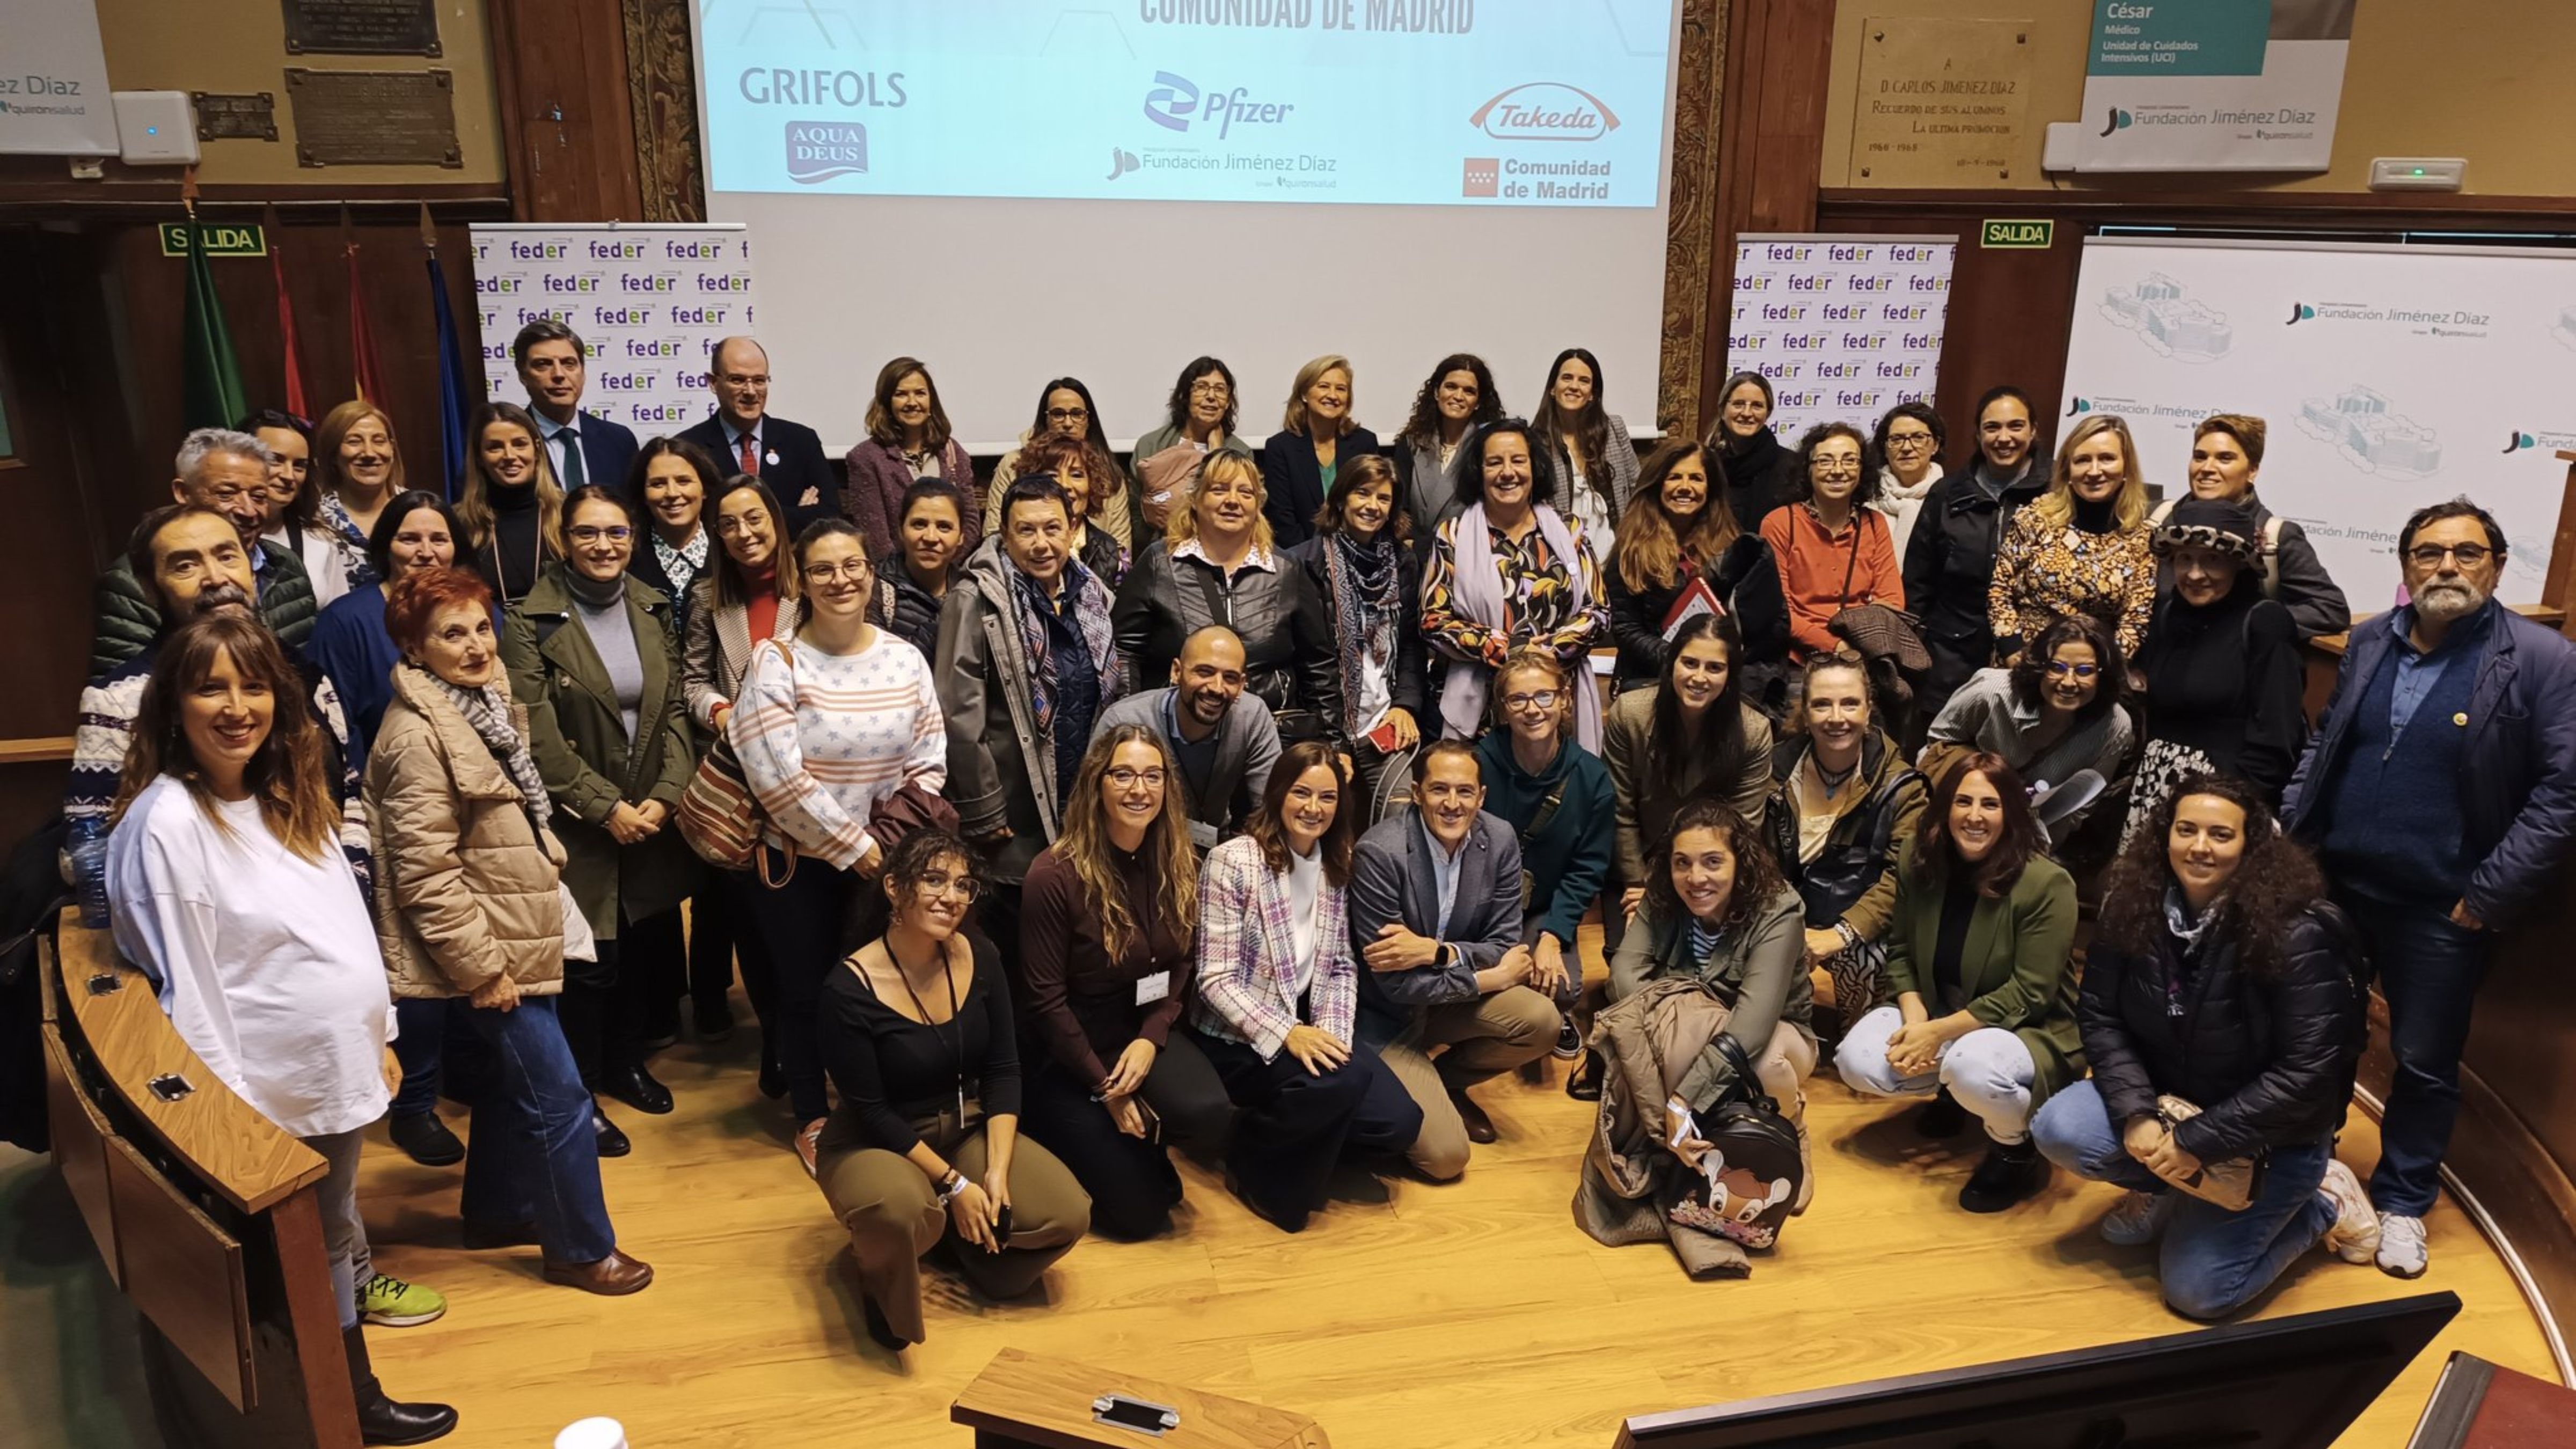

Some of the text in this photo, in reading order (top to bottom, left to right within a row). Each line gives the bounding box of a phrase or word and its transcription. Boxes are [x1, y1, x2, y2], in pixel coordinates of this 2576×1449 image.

[1140, 0, 1474, 34] COMUNIDAD DE MADRID
[2107, 2, 2154, 19] César
[2104, 25, 2141, 34] Médico
[2103, 40, 2199, 50] Unidad de Cuidados
[2101, 53, 2176, 64] Intensivos (UCI)
[740, 67, 907, 107] GRIFOLS
[1893, 80, 1935, 93] CARLOS
[1940, 80, 1988, 94] JIMENEZ
[1990, 81, 2016, 94] DIAZ
[1203, 87, 1294, 140] Pfizer
[1499, 105, 1597, 129] Takeda
[2134, 112, 2207, 125] Fundación
[2211, 109, 2275, 125] Jiménez
[793, 128, 860, 145] AQUA
[796, 145, 858, 160] DEUS
[1143, 154, 1220, 170] Fundación
[1225, 153, 1294, 171] Jiménez
[1505, 159, 1611, 175] Comunidad
[1504, 181, 1609, 199] de Madrid
[171, 228, 254, 248] SLIDA
[1989, 224, 2044, 241] SALIDA
[510, 241, 721, 259] feder feder feder
[1767, 244, 1812, 260] feder
[1829, 245, 1874, 261] feder
[1890, 245, 1934, 261] feder
[475, 273, 750, 292] eder feder feder feder
[1733, 275, 1772, 290] eder
[1788, 274, 1832, 290] feder
[1849, 274, 1893, 290] feder
[595, 306, 650, 324] feder
[671, 306, 726, 323] feder
[1762, 304, 1806, 319] feder
[1823, 304, 1867, 319] feder
[1883, 304, 1927, 319] feder
[2317, 307, 2383, 320] Fundación
[2386, 309, 2450, 324] Jiménez
[626, 339, 681, 356] feder
[1728, 334, 1767, 348] eder
[1783, 333, 1826, 348] feder
[1843, 333, 1886, 348] feder
[1758, 362, 1801, 377] feder
[1818, 362, 1861, 377] feder
[1877, 362, 1921, 377] feder
[600, 371, 708, 389] feder fed
[1778, 391, 1821, 406] feder
[1837, 391, 1880, 405] feder
[632, 404, 686, 420] feder
[2092, 401, 2149, 414] Fundación
[2152, 405, 2207, 419] Jiménez
[2345, 526, 2397, 543] Jiméne
